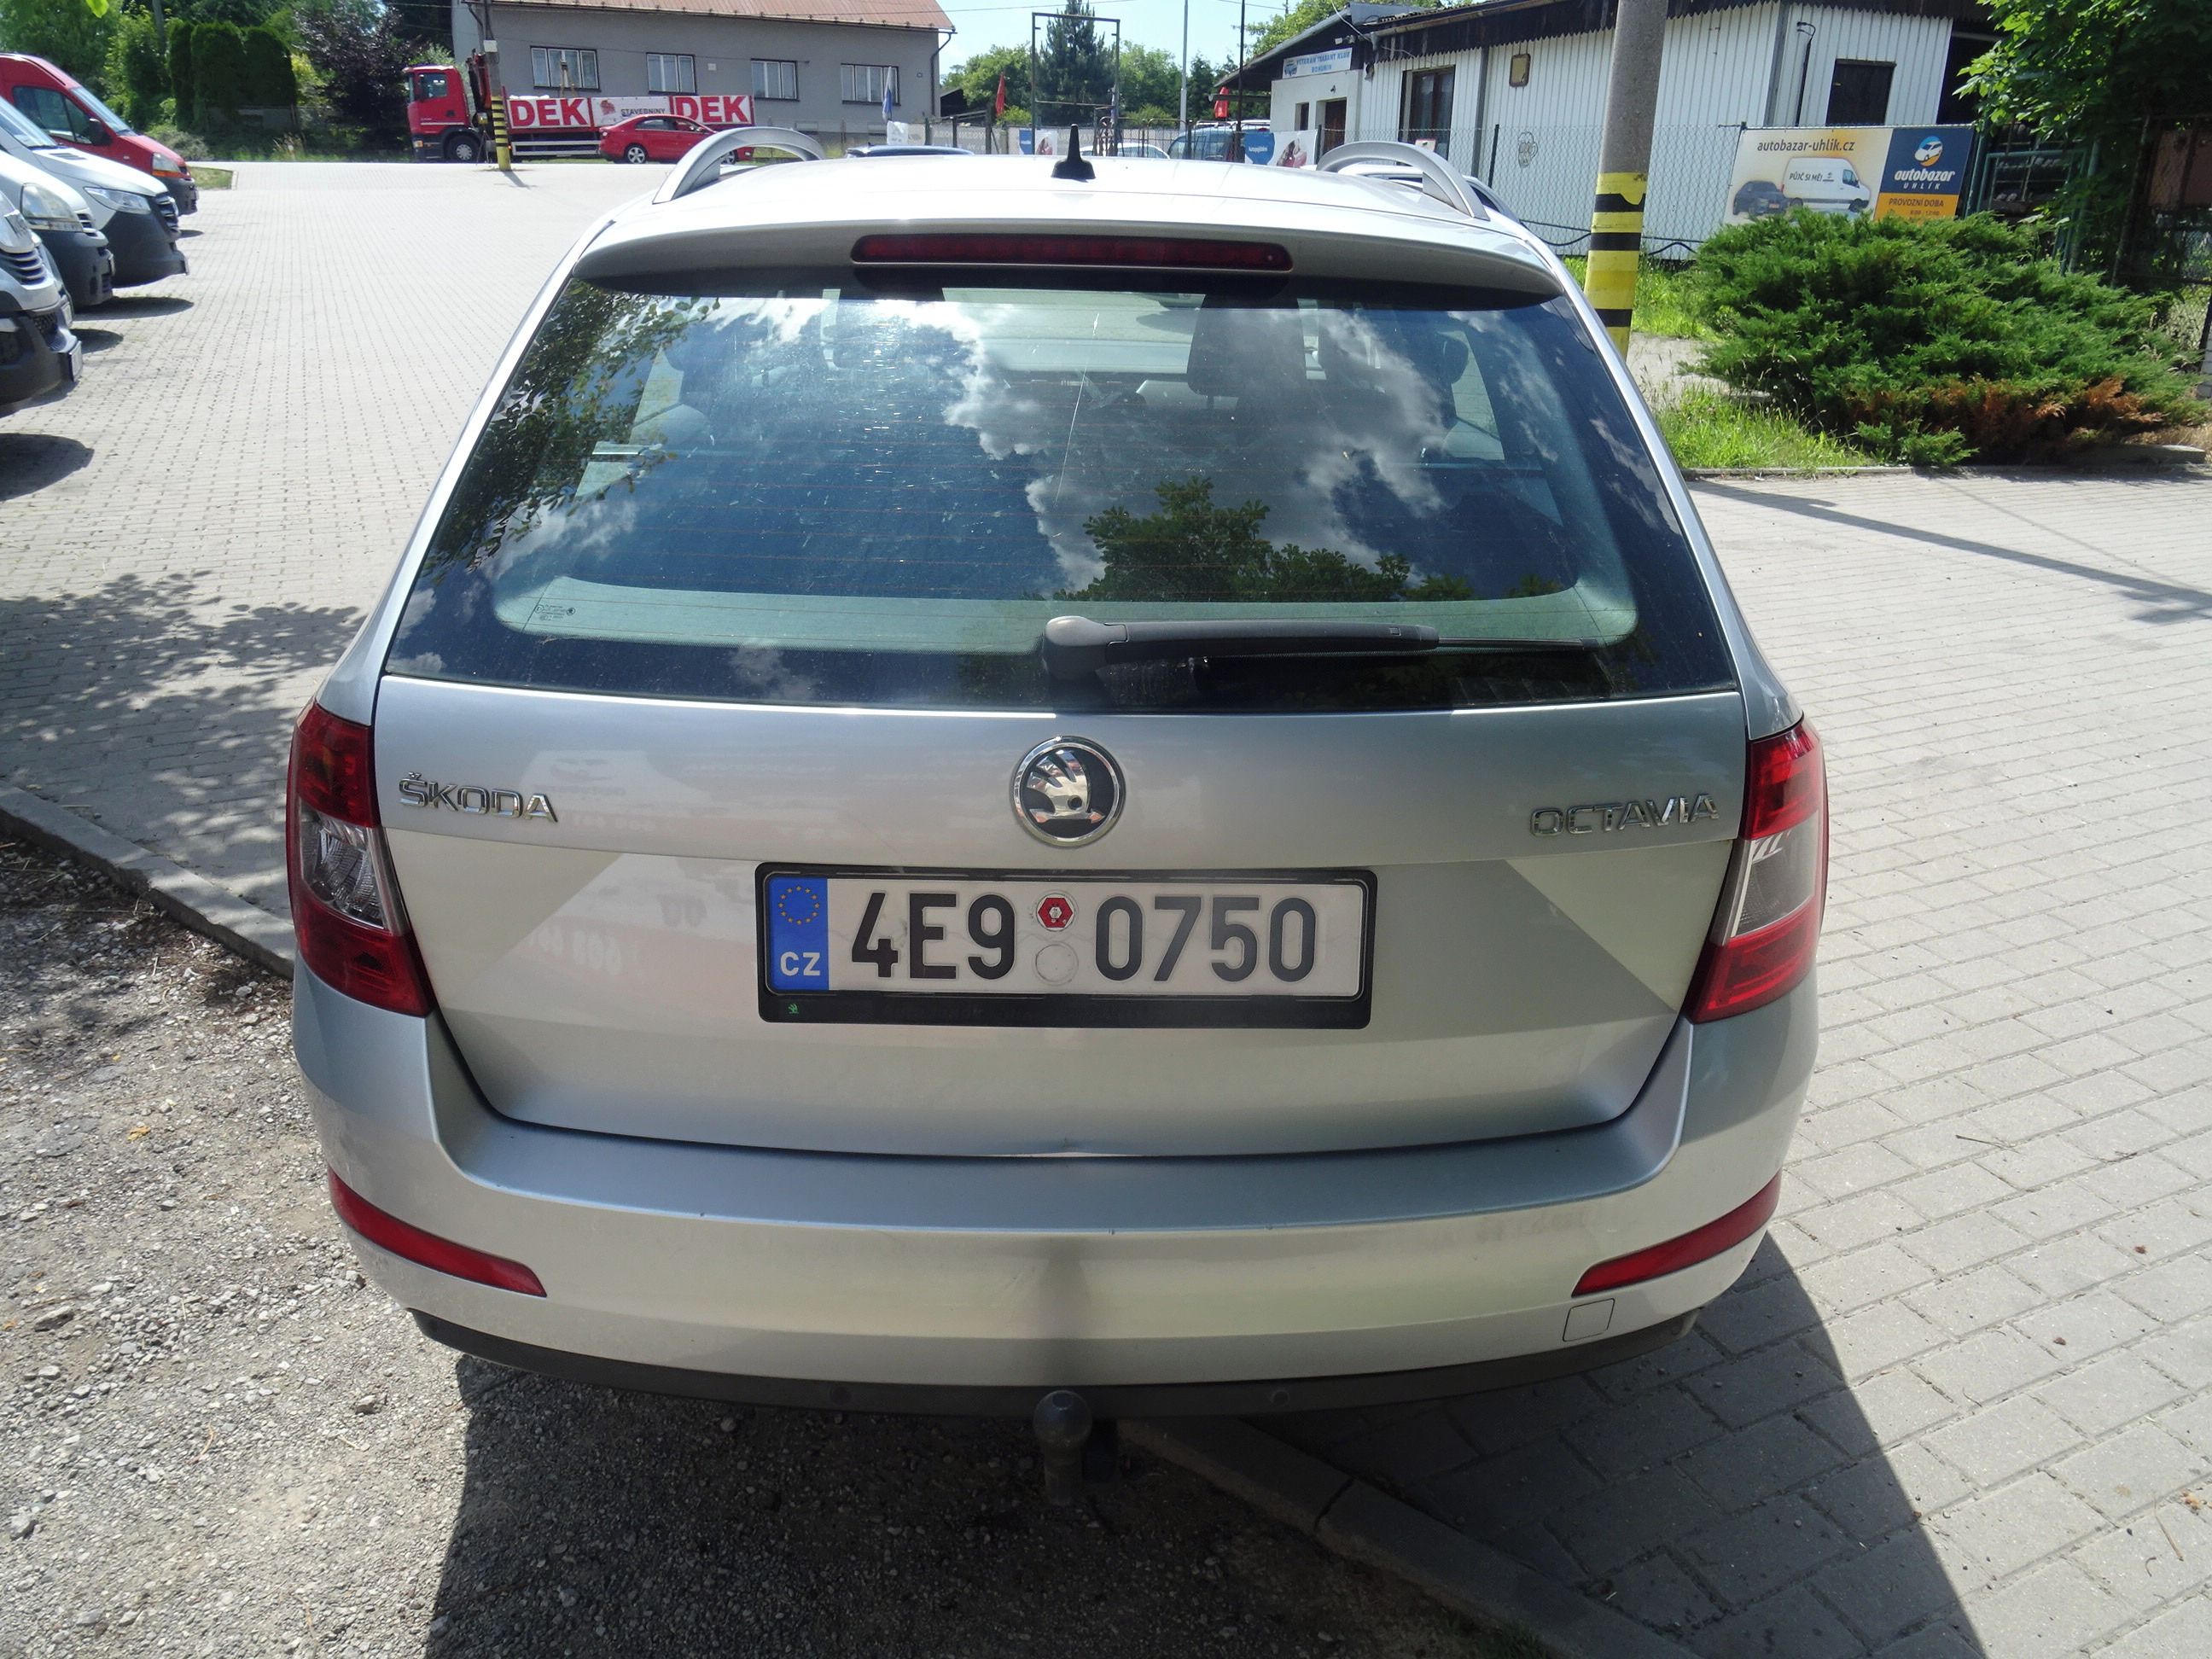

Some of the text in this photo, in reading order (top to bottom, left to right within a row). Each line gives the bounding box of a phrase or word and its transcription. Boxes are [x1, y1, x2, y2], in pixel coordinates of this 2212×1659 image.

[509, 98, 588, 126] DEK
[675, 96, 748, 123] DEK
[1757, 138, 1856, 152] autobazar-uhlik.cz
[1894, 168, 1956, 182] autobazar
[1889, 196, 1945, 207] PROVOZNÍ DOBA
[399, 771, 558, 823] ŠKODA
[1530, 793, 1720, 836] OCTAVIA
[851, 892, 1316, 983] 4E9 0750
[780, 951, 821, 976] CZ
